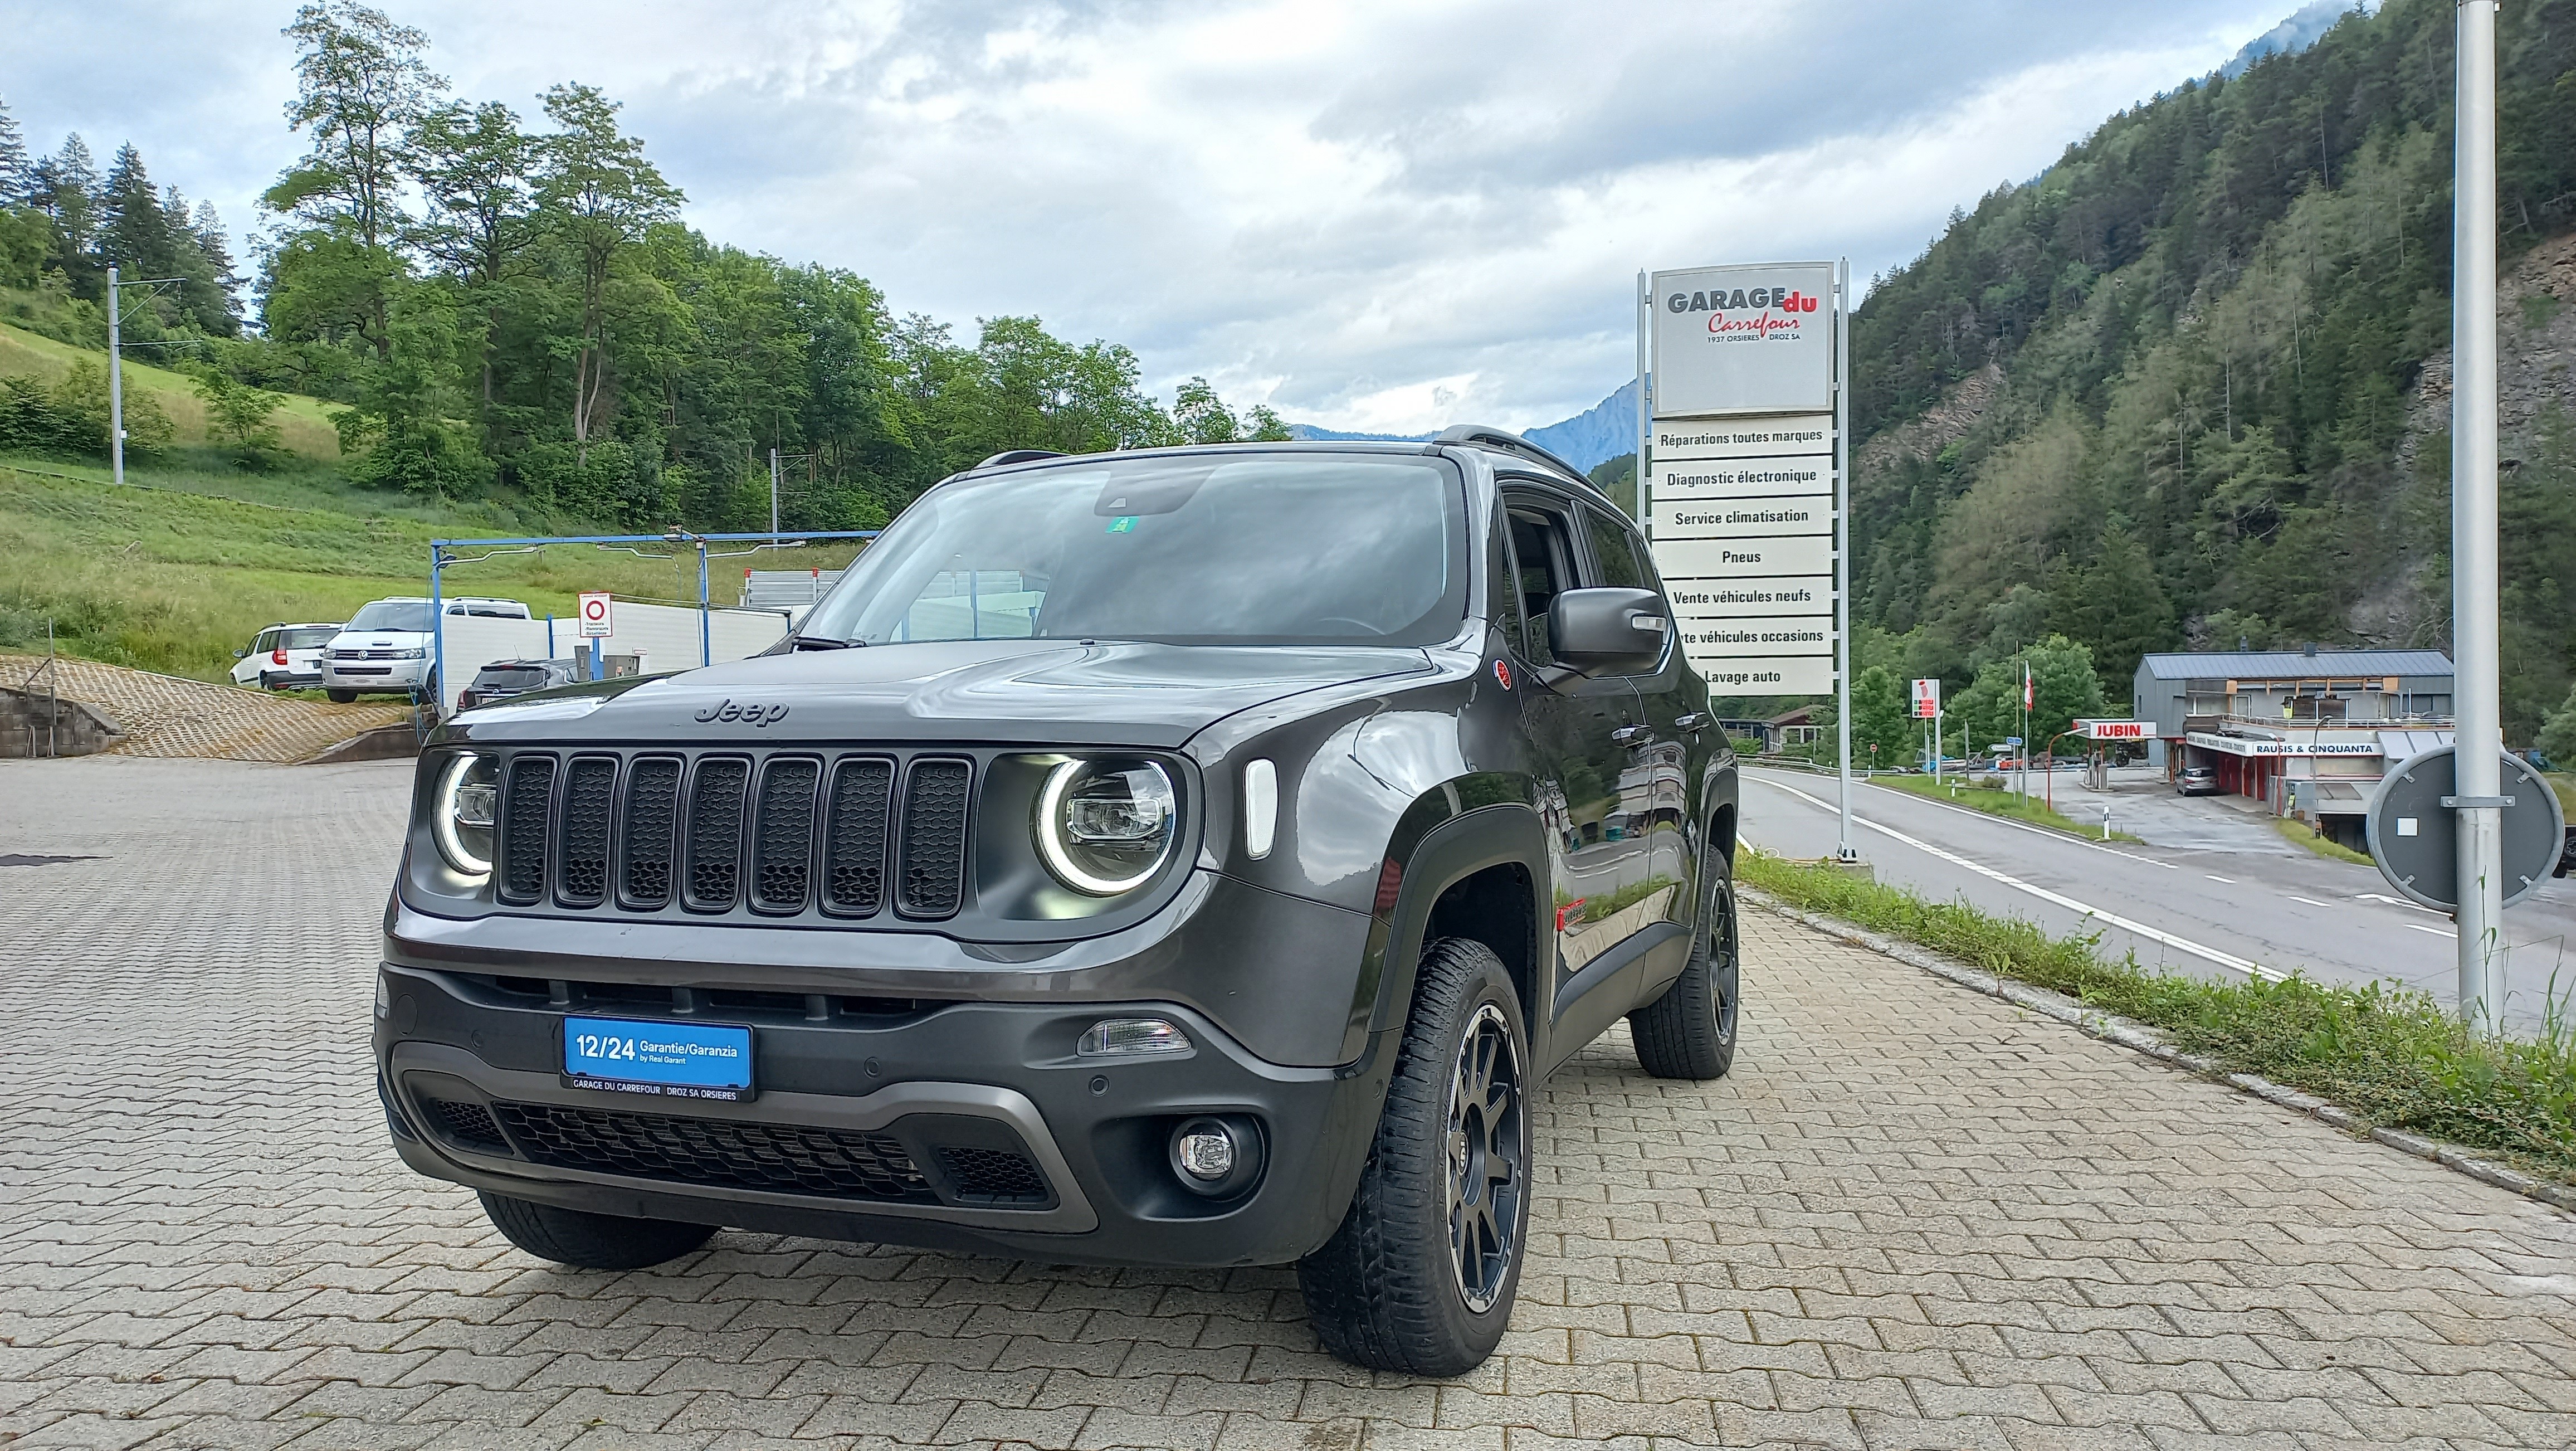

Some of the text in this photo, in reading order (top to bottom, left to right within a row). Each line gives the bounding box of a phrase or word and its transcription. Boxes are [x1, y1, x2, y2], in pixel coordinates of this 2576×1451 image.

[1668, 288, 1817, 313] GARAGE du
[1708, 311, 1800, 338] Carrefour
[1661, 430, 1822, 449] Réparations toutes marques
[1667, 469, 1817, 488] Diagnostic électronique
[1675, 509, 1808, 525] Service climatisation
[1723, 551, 1761, 563] Pneus
[1674, 589, 1811, 604] Vente véhicules neufs
[1700, 630, 1758, 643] véhicules
[1761, 629, 1823, 642] occasions
[1705, 670, 1781, 685] Lavage auto
[694, 699, 790, 728] Jeep
[2097, 725, 2141, 737] JUBIN
[2309, 745, 2373, 753] CINQUANTA
[576, 1034, 738, 1060] 12/24 Garantie/Garanzia
[640, 1055, 647, 1063] by
[573, 1079, 736, 1100] GARAGE DU CARREFOUR DROZ SA ORSIERES
